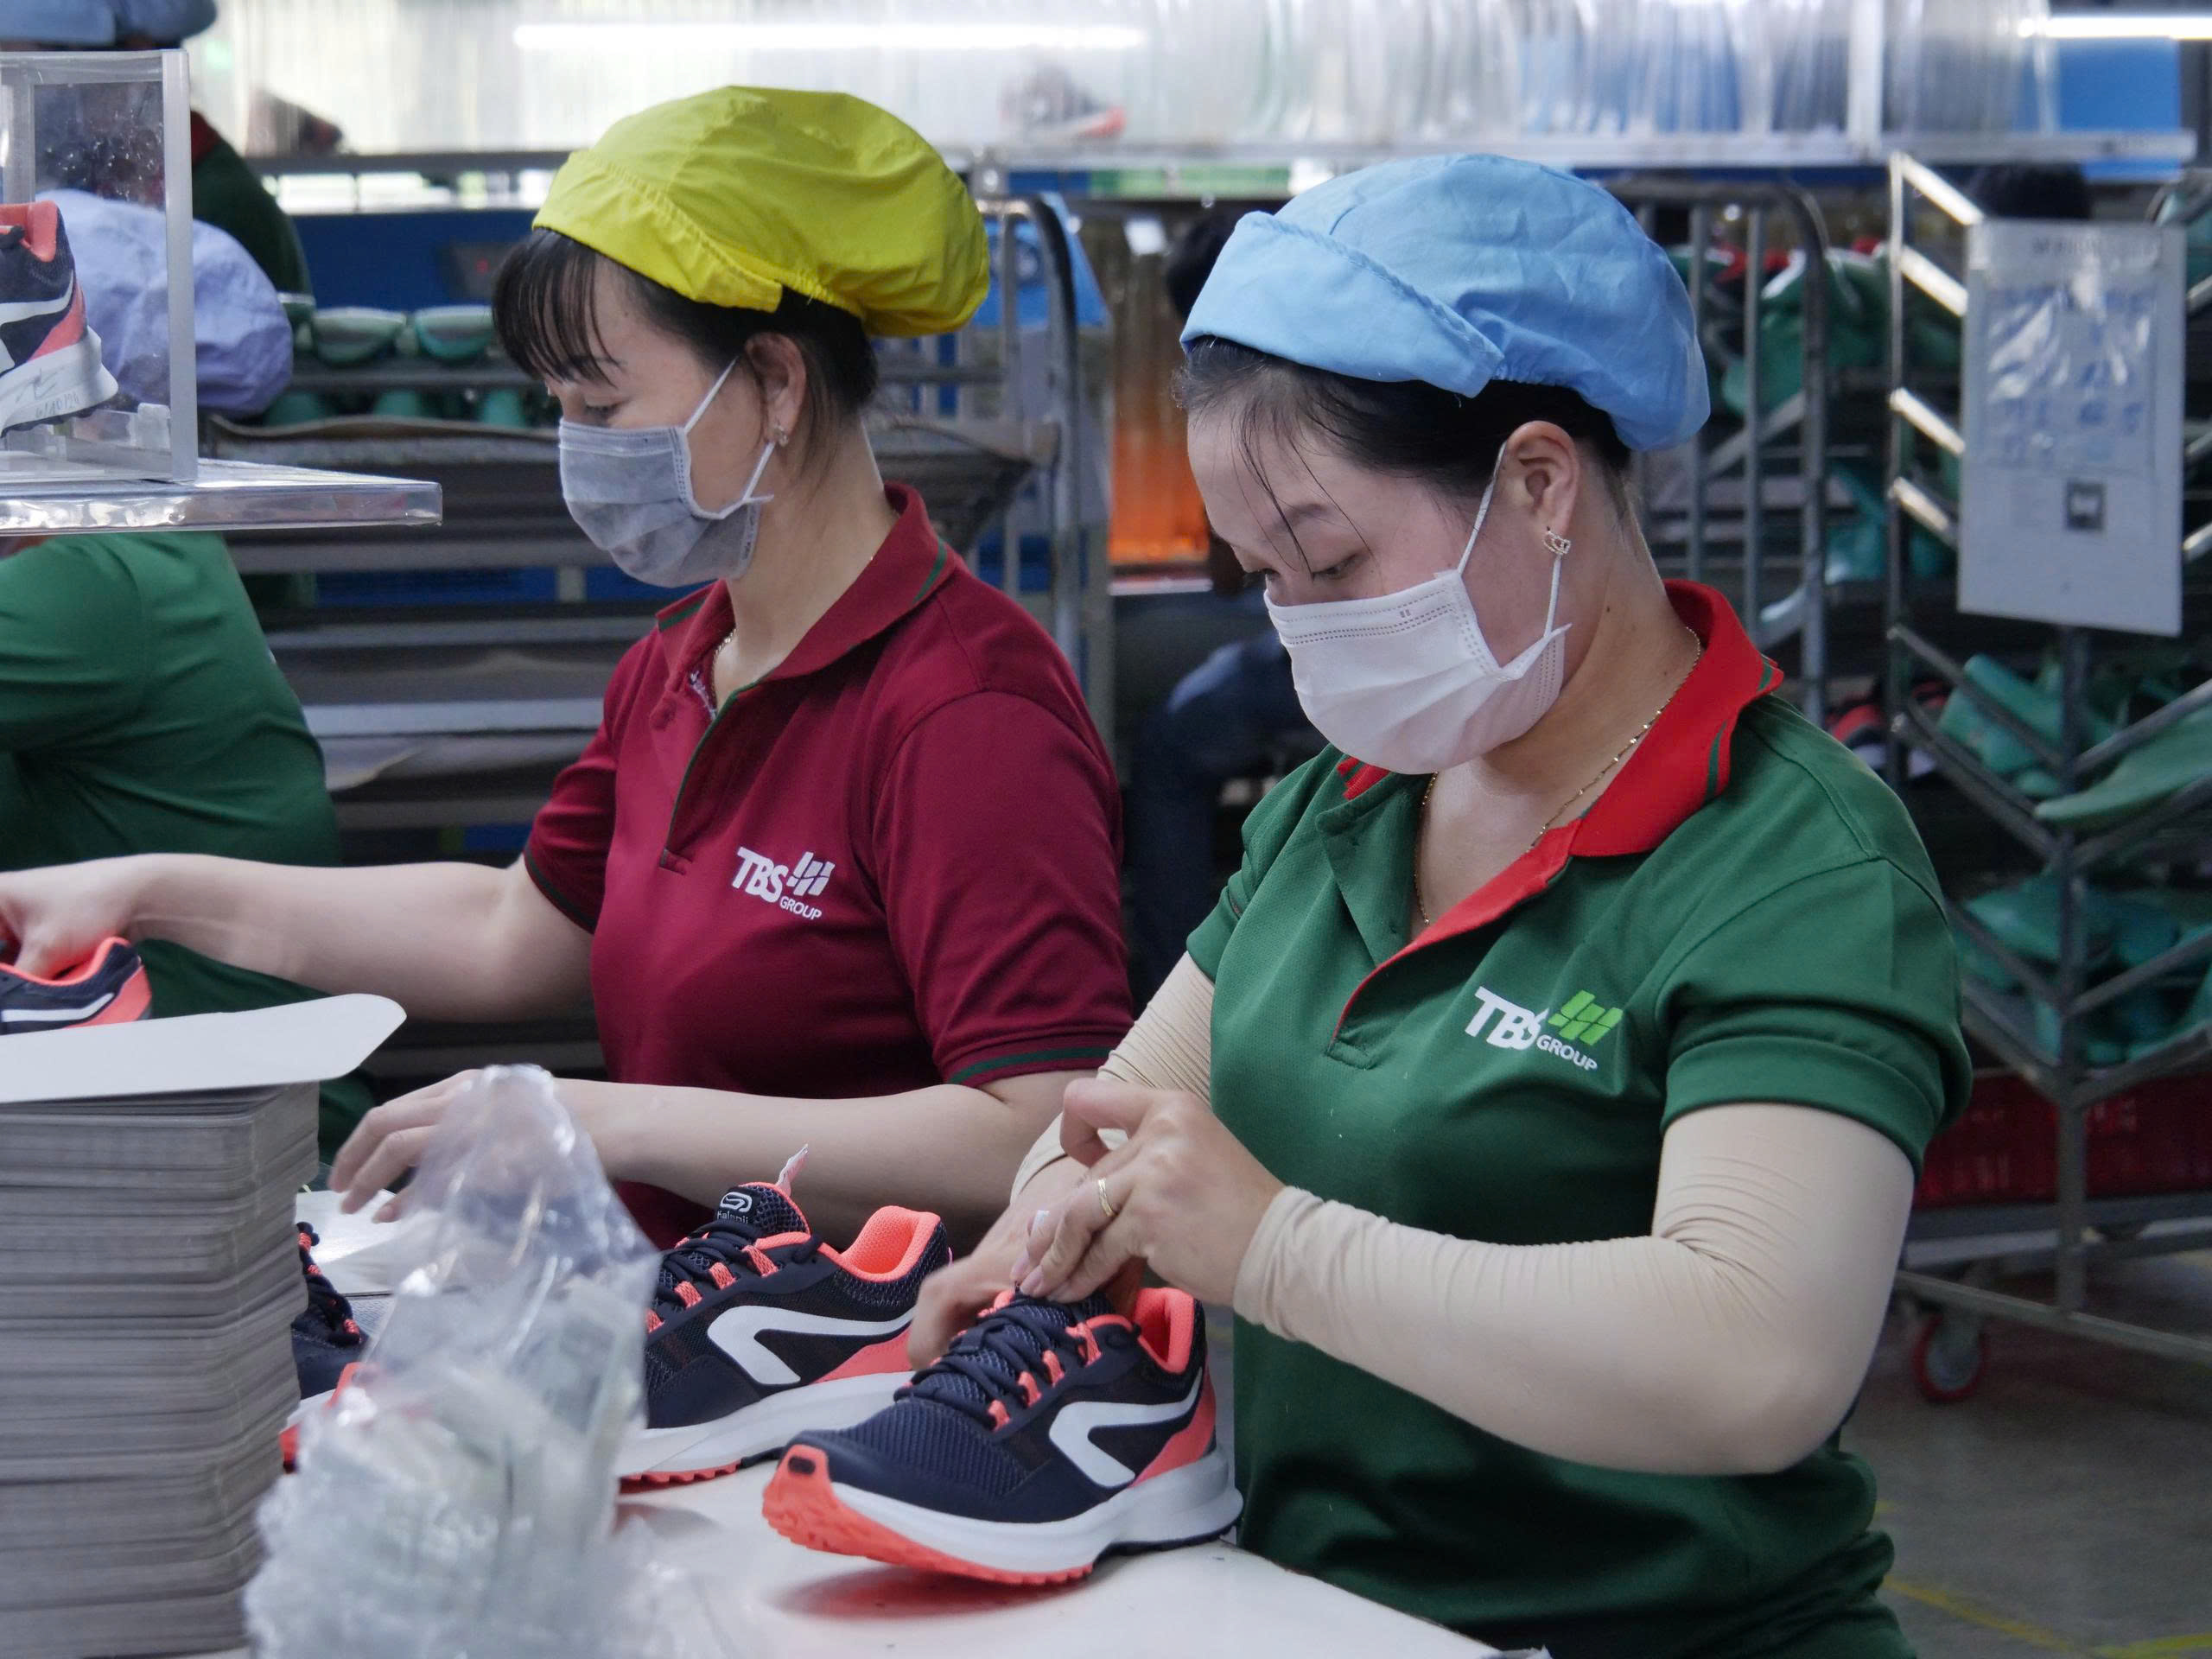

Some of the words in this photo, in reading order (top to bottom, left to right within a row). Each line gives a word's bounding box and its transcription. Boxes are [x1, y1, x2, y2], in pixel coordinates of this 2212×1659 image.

[732, 847, 789, 903] TBS
[779, 895, 823, 920] GROUP
[1536, 1033, 1599, 1071] GROUP
